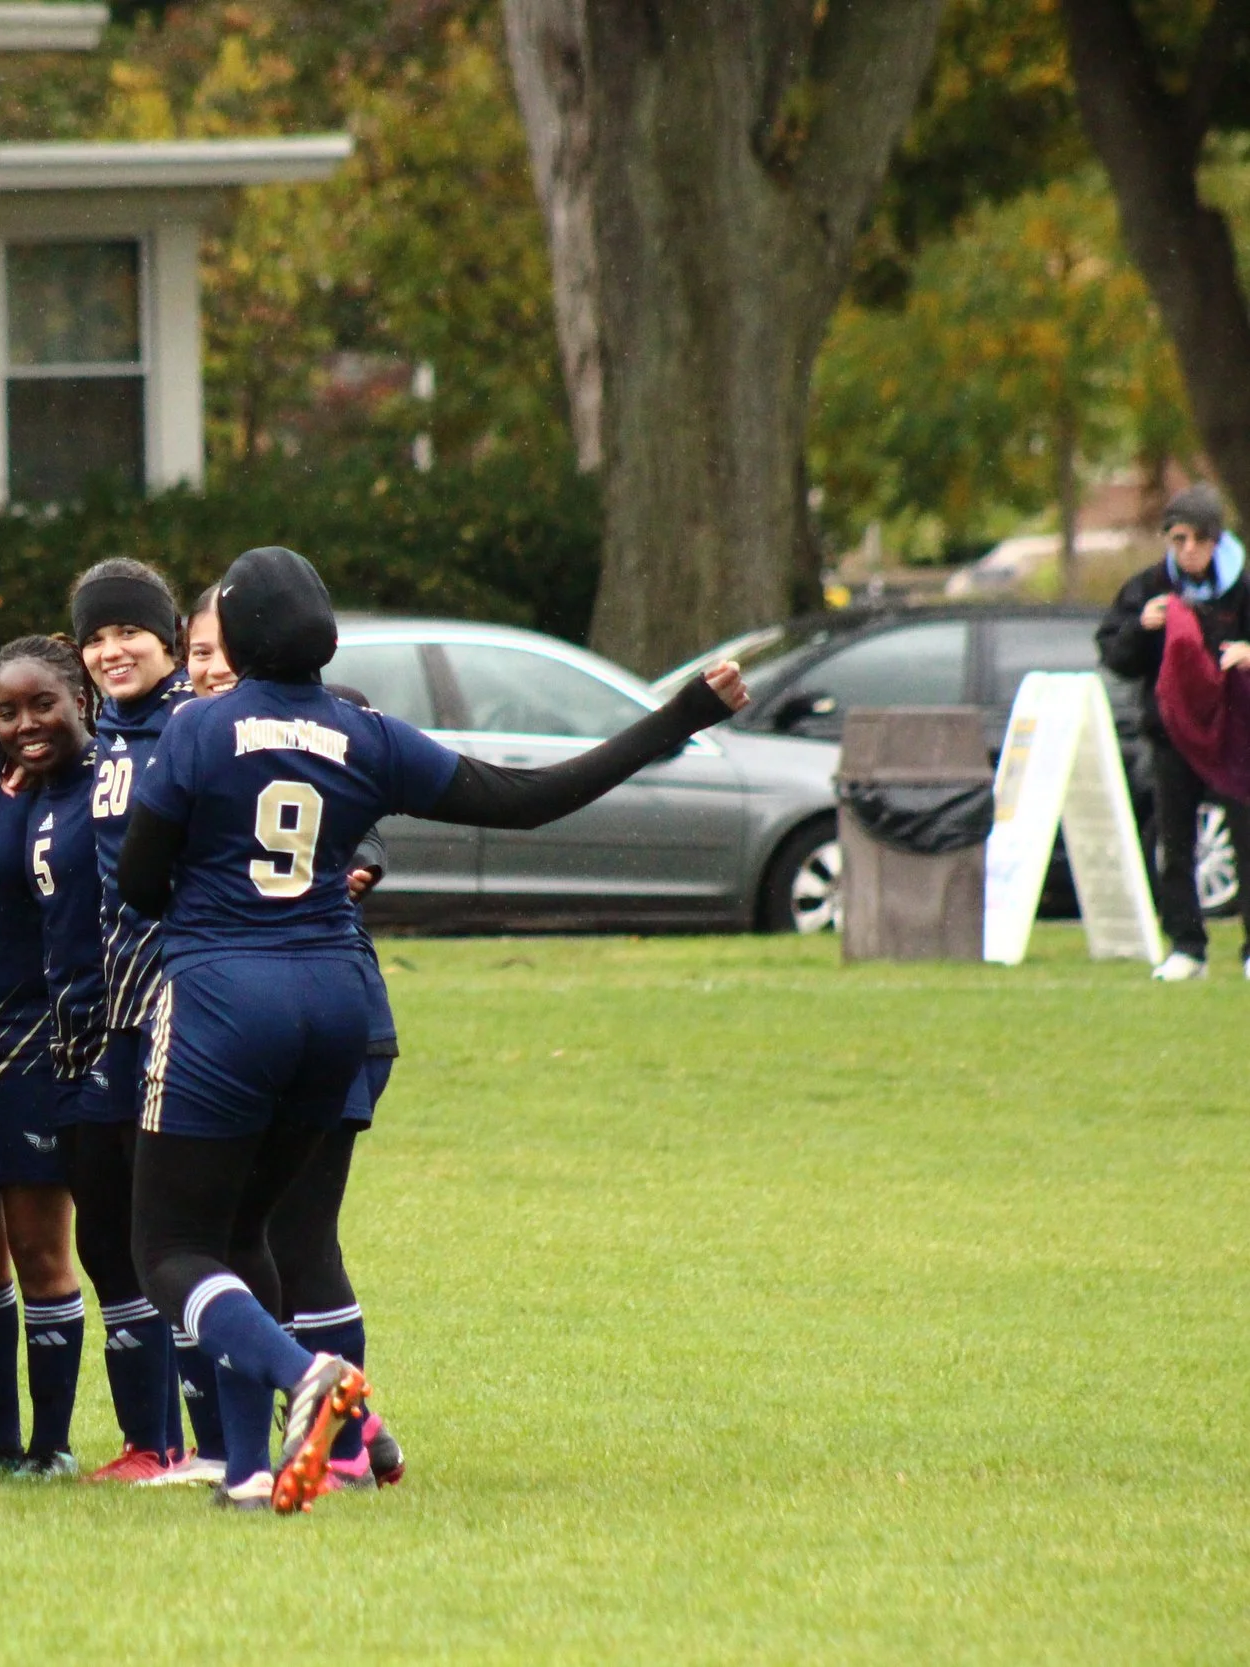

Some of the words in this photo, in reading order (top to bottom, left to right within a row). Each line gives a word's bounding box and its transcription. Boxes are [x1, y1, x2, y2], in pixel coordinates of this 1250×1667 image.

[92, 757, 133, 818] 20
[32, 837, 55, 896] 5
[250, 779, 323, 898] 9
